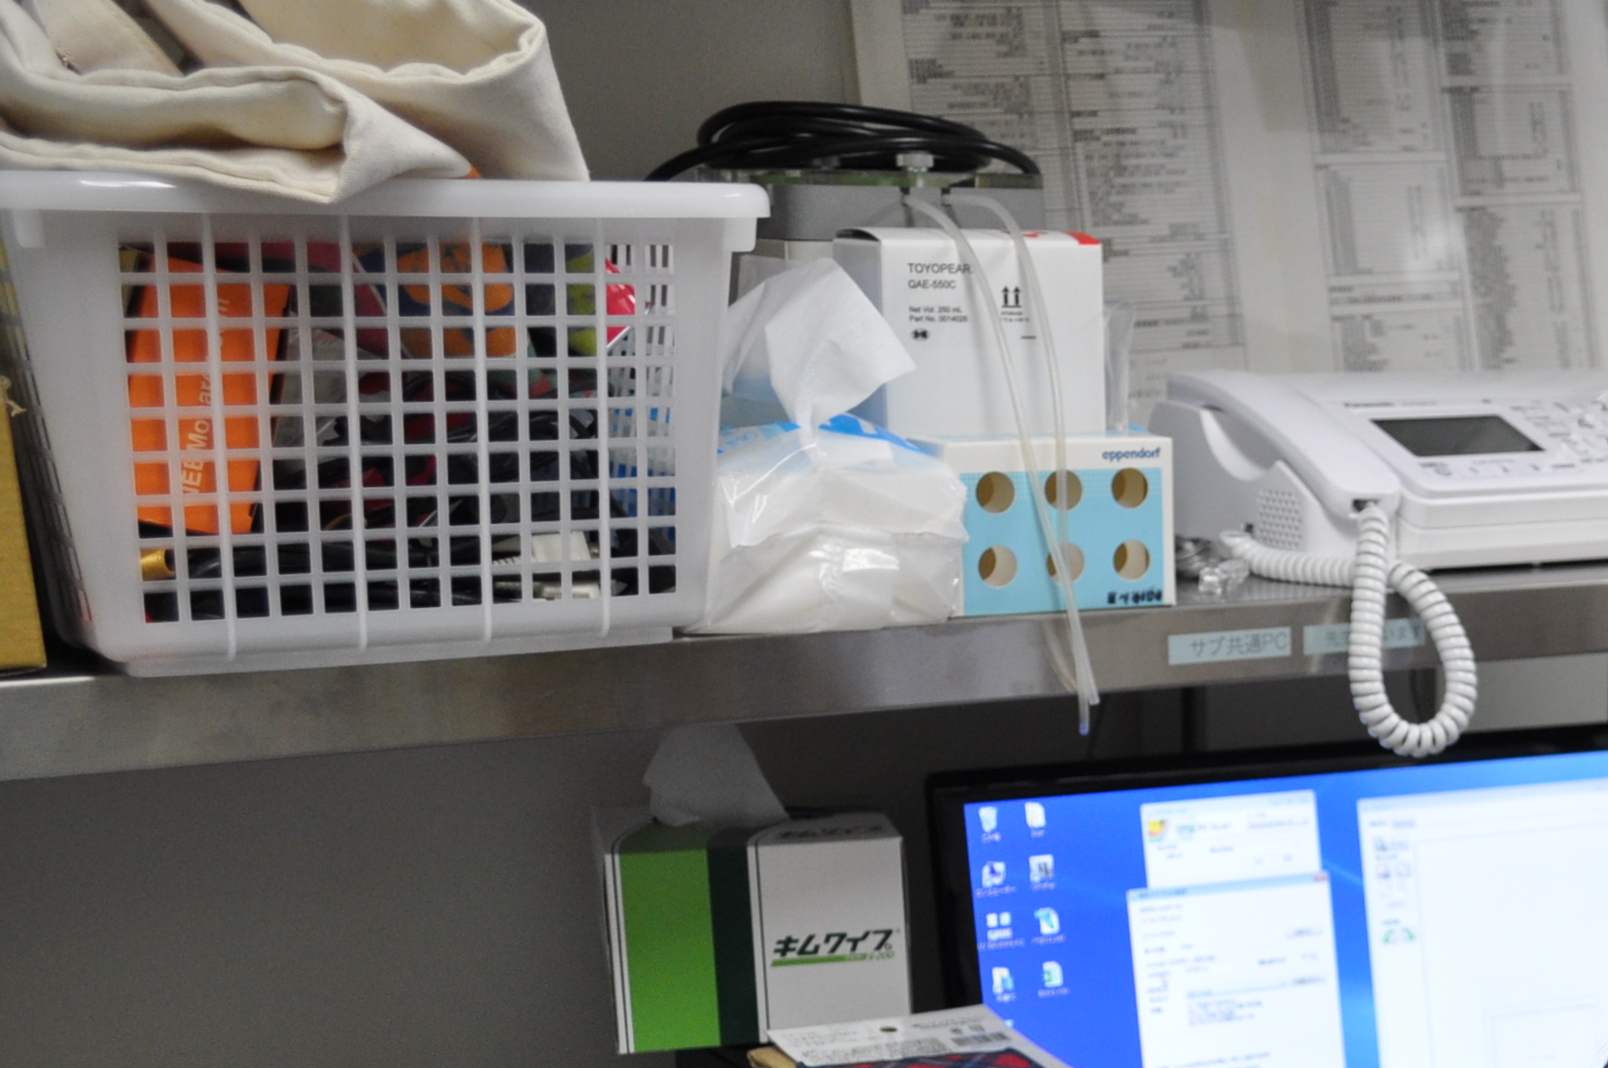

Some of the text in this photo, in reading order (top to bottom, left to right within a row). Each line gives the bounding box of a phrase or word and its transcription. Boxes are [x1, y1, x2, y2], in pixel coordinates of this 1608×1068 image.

[907, 262, 974, 274] TOYOPEAR
[907, 278, 957, 290] QAE-550C
[1102, 447, 1161, 463] eppendorf
[1189, 632, 1288, 657] サブ共通PC
[773, 928, 894, 958] キムワイプ
